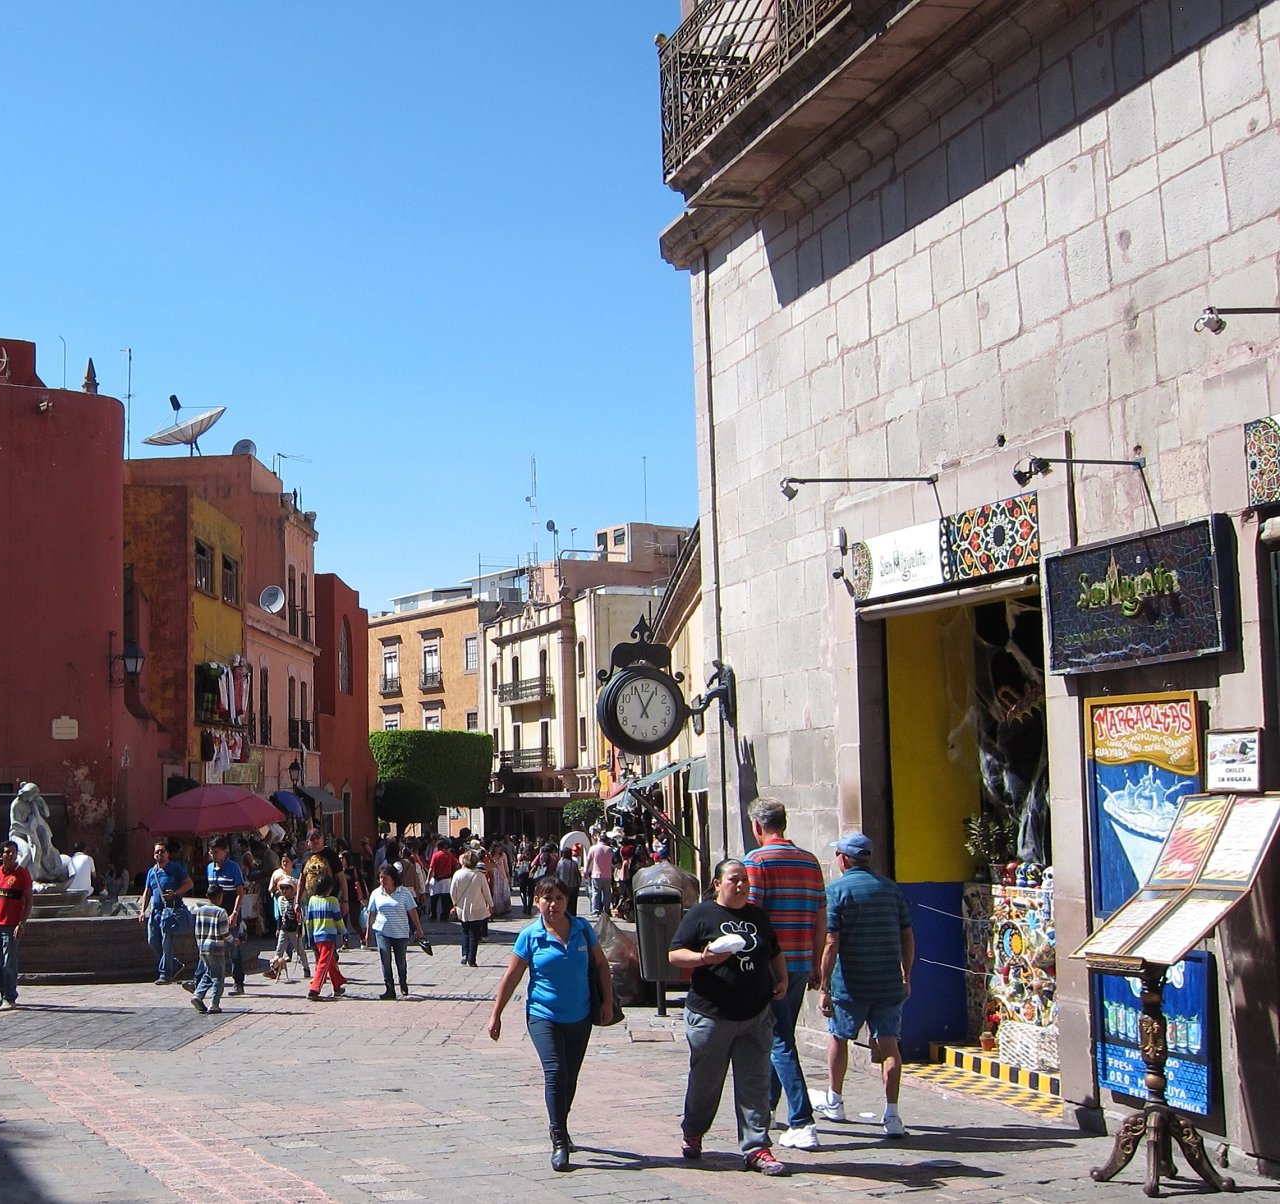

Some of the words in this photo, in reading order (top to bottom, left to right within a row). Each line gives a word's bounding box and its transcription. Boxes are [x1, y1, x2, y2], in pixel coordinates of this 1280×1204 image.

[641, 683, 650, 693] 12
[621, 694, 631, 704] 10
[661, 695, 667, 705] 2
[619, 705, 625, 715] 9
[666, 706, 671, 716] 3
[622, 717, 628, 727] 8
[660, 718, 668, 727] 4
[631, 726, 637, 735] 7
[652, 726, 658, 736] 5
[1108, 1058, 1134, 1072] FRESA
